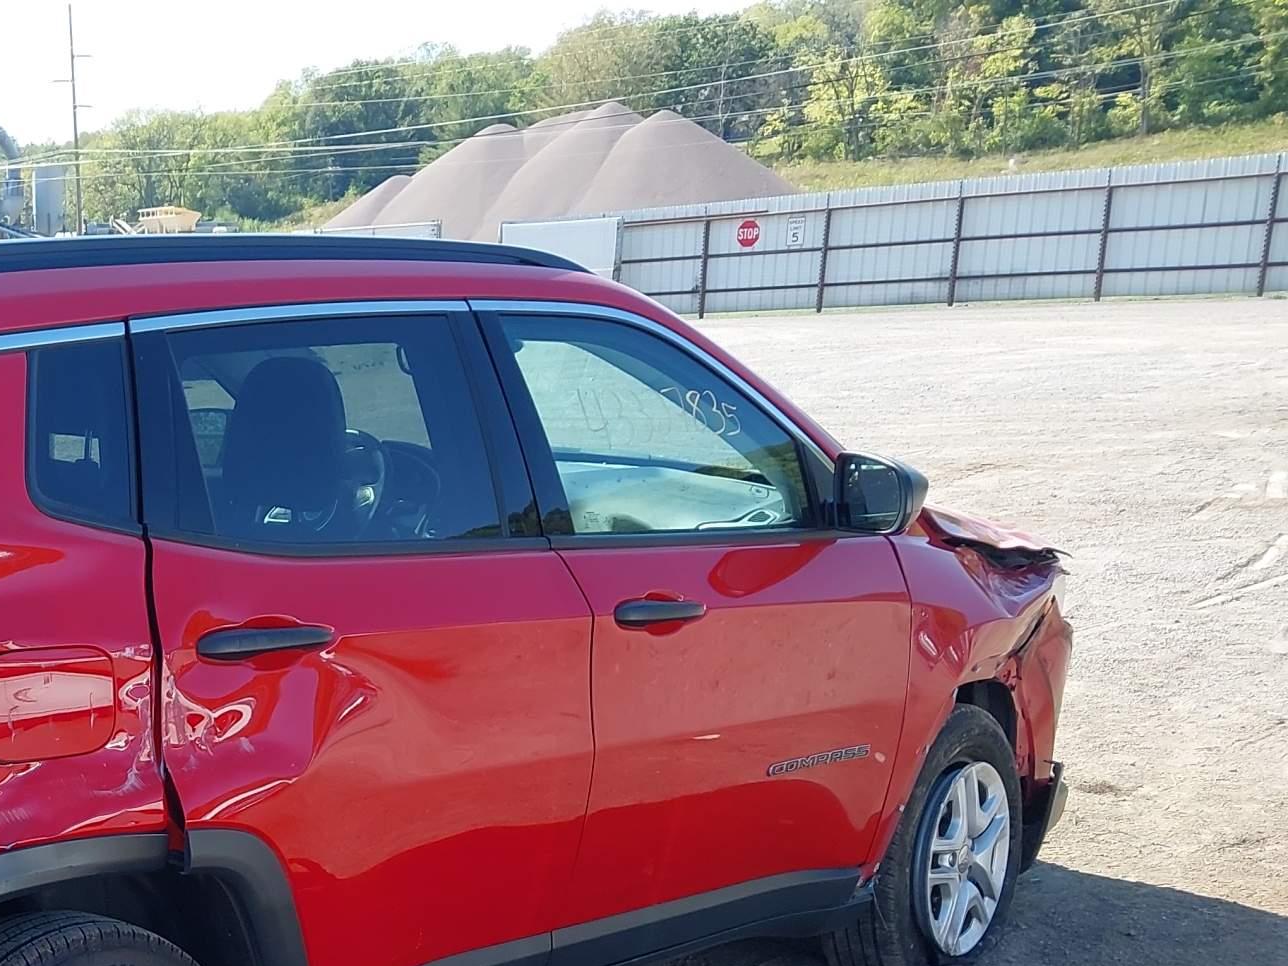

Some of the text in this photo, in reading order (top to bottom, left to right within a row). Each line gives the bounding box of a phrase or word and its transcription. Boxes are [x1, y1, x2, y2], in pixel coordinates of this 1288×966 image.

[738, 227, 759, 240] STOP
[791, 232, 799, 243] 5
[767, 744, 872, 777] COMPASS
